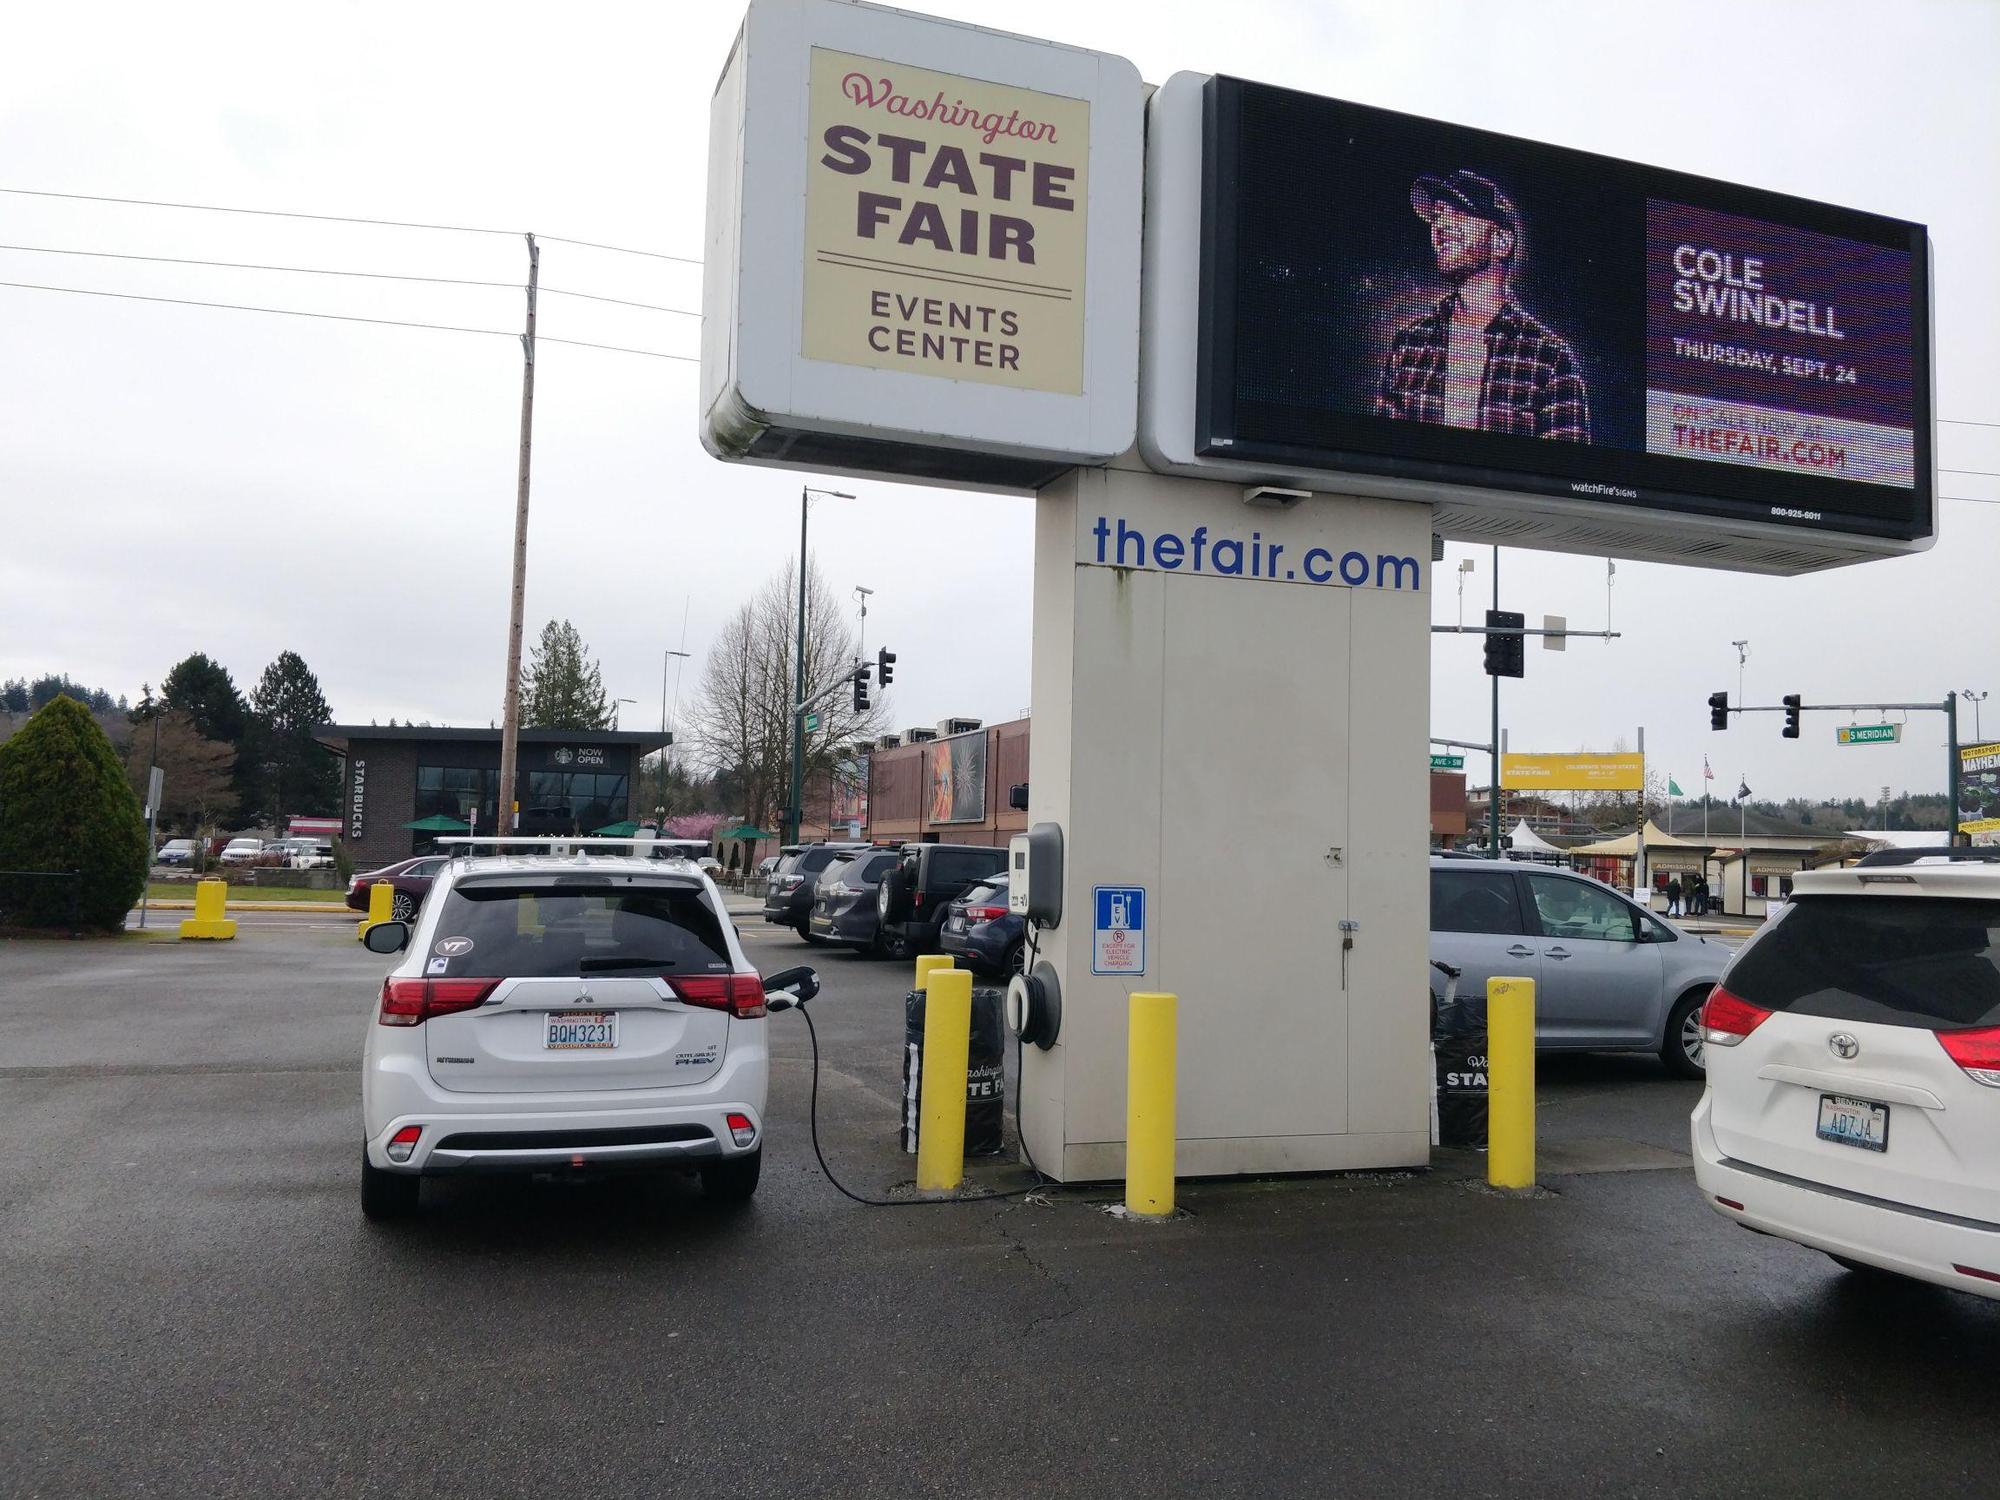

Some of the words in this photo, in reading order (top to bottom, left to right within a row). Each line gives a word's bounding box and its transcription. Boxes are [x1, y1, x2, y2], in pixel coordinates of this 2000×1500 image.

[842, 72, 1057, 144] Washington
[820, 124, 1075, 212] STATE
[857, 190, 1036, 265] FAIR
[1673, 245, 1764, 290] COLE
[871, 290, 1020, 337] EVENTS
[1673, 279, 1846, 340] SWINDELL
[867, 326, 1020, 371] CENTER
[1673, 337, 1777, 375] THURSDAY,
[1782, 355, 1830, 382] SEPT.
[1834, 365, 1857, 384] 24
[1673, 424, 1847, 469] THEFAIR.COM
[1770, 506, 1822, 521] 800-925-6011
[1093, 516, 1420, 591] thefair.com
[578, 748, 602, 756] NOW
[1850, 731, 1855, 740] S
[1857, 728, 1893, 740] MERIDIAN
[577, 756, 604, 764] OPEN
[351, 760, 366, 838] STARBUCKS
[1656, 863, 1698, 871] ADMISSION
[444, 941, 468, 951] VT
[549, 1024, 614, 1043] BQH3231
[1446, 1072, 1488, 1086] STA
[1824, 1104, 1861, 1115] WASHINGTON
[1835, 1096, 1871, 1109] RENTON
